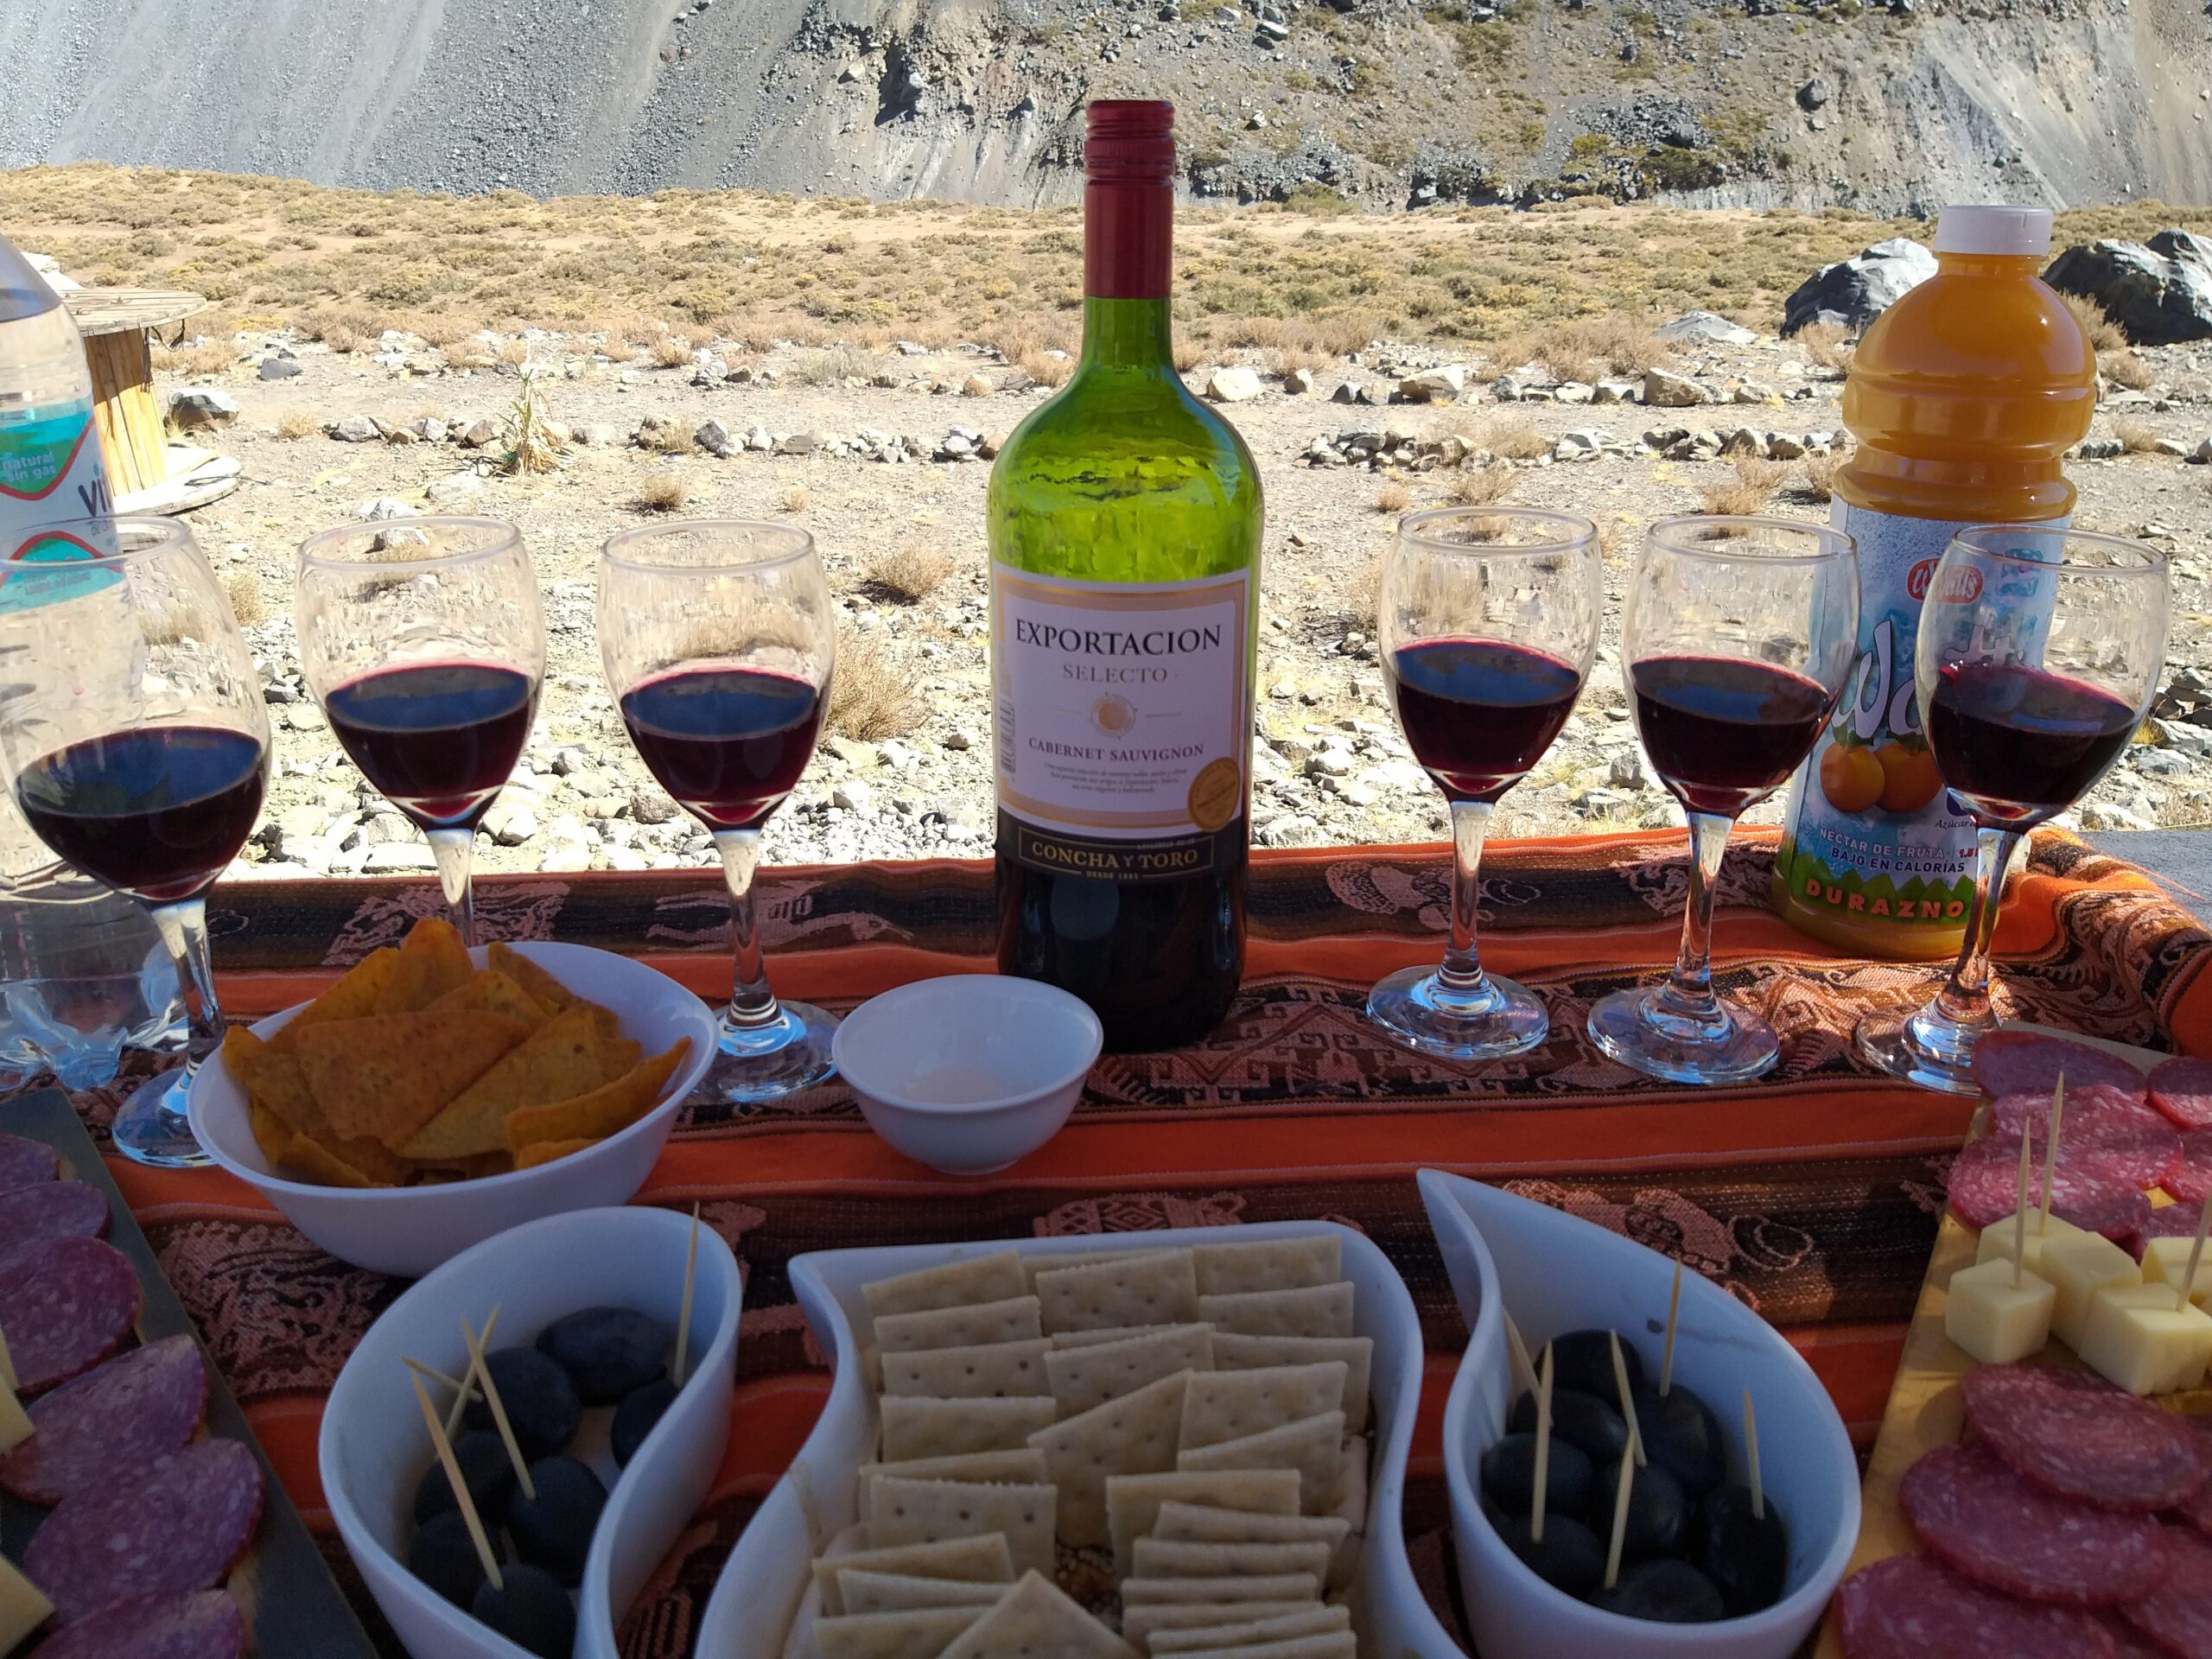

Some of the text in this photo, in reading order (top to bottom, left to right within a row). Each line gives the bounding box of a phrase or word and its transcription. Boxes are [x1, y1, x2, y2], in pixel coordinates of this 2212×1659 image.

[3, 452, 54, 470] natural
[33, 465, 56, 480] gas
[1016, 617, 1221, 656] EXPORTACION
[1063, 663, 1167, 683] SELECTO
[1029, 737, 1205, 762] CABERNET SAUVIGNON
[1032, 841, 1120, 868] CONCHA
[1122, 855, 1134, 868] Y
[1138, 849, 1198, 869] TORO
[1820, 827, 1945, 859] NÉCTAR DE FRUTA
[1831, 847, 1966, 873] BAJO EN CALORÍAS
[1806, 879, 1965, 918] DURAZNO
